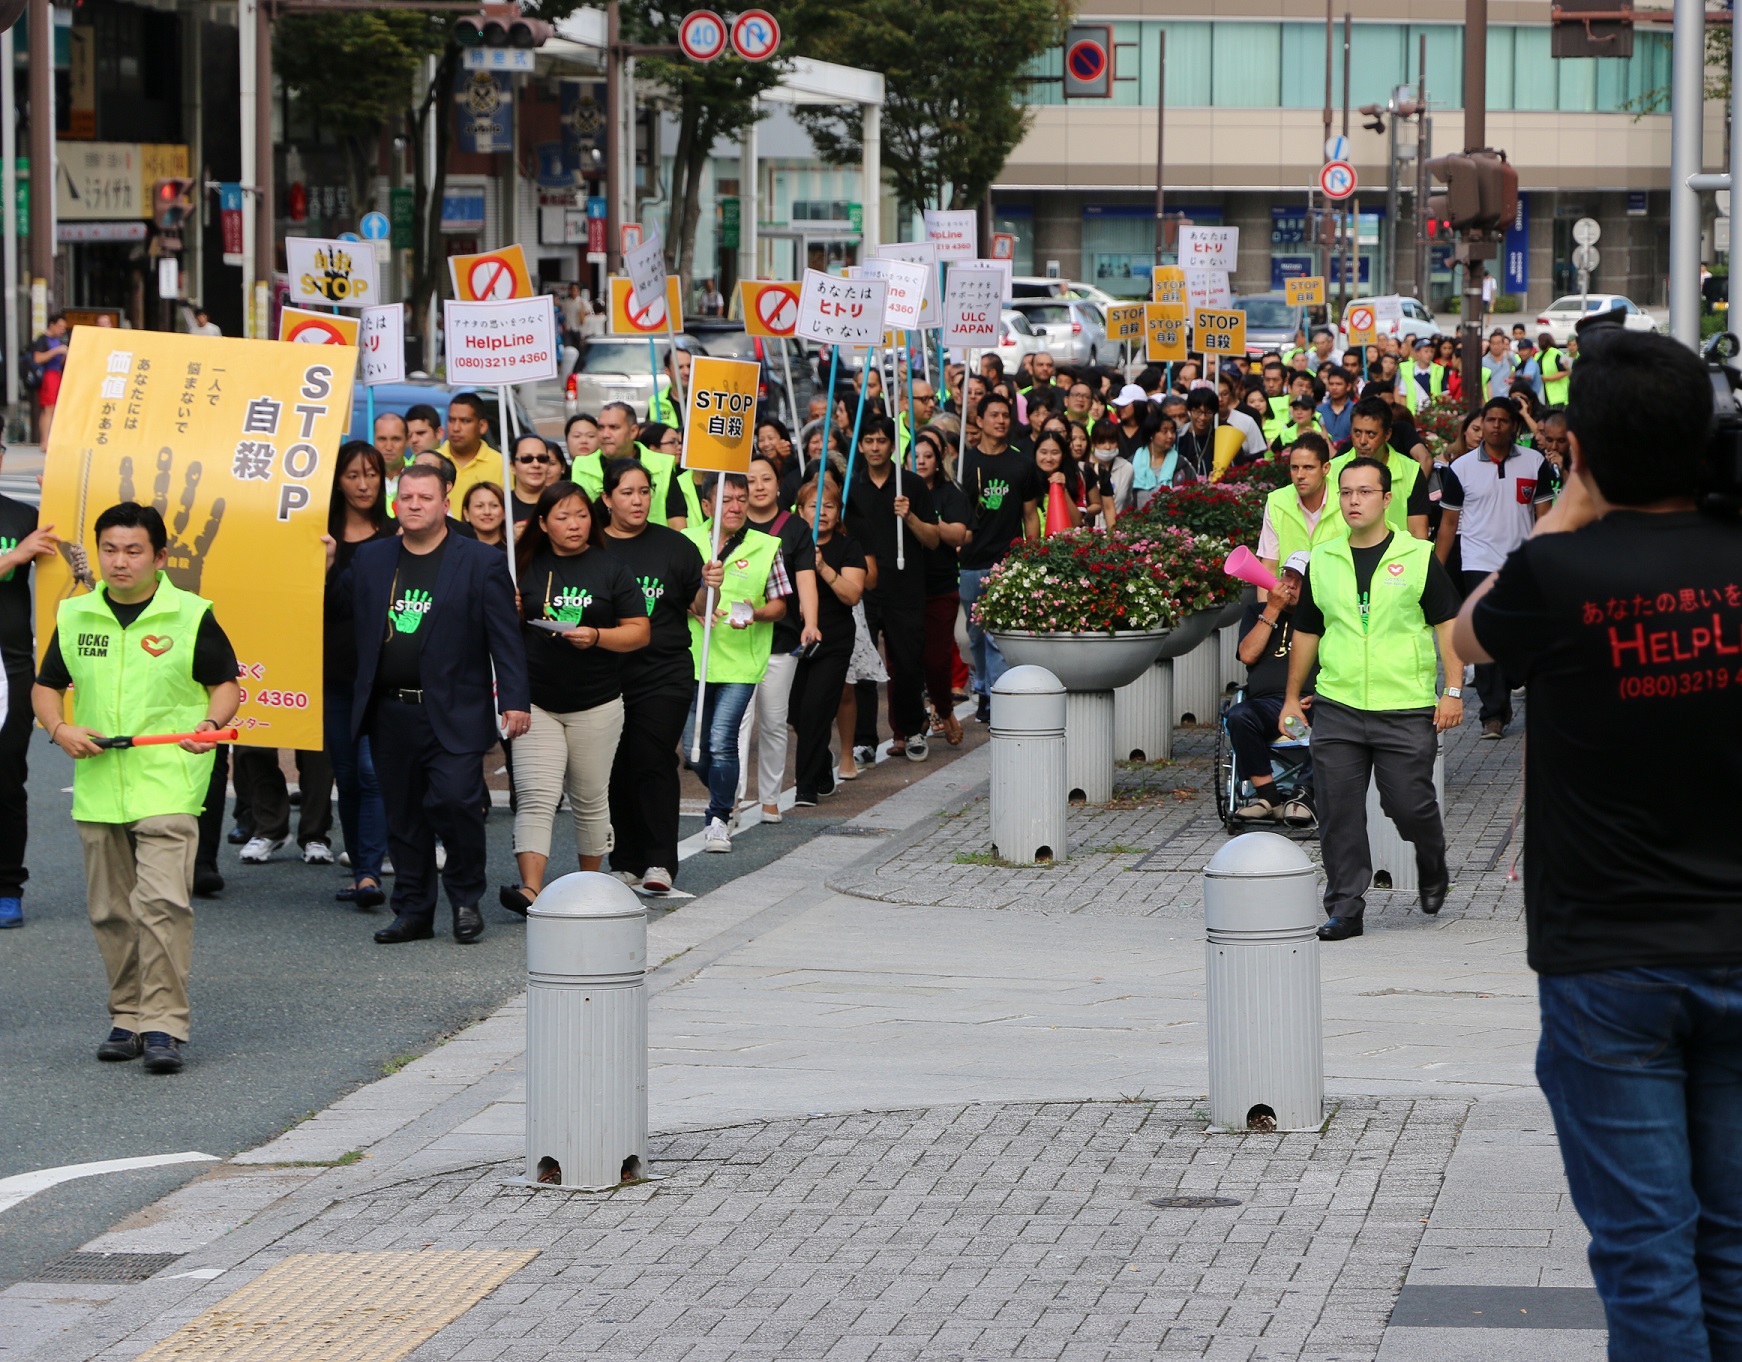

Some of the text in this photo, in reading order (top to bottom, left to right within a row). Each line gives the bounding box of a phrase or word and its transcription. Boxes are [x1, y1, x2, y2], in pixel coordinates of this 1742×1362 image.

[690, 25, 716, 46] 40
[1190, 232, 1228, 240] あなたは
[1194, 243, 1222, 252] ヒトリ
[1190, 257, 1227, 266] じゃない
[300, 274, 368, 298] STOP
[817, 281, 872, 299] あなたは
[1157, 281, 1185, 290] STOP
[1291, 281, 1319, 290] STOP
[819, 299, 863, 318] ヒトリ
[888, 304, 913, 314] 4360
[961, 312, 986, 321] ULC
[1112, 307, 1144, 320] STOP
[454, 314, 544, 329] アナタの思いをつなぐ
[812, 320, 868, 336] じゃない
[952, 324, 993, 333] JAPAN
[1150, 319, 1182, 330] STOP
[1199, 313, 1239, 330] STOP
[465, 333, 534, 351] HelpLine
[1206, 333, 1231, 349] 自殺
[455, 351, 548, 369] (080)3219 4360
[124, 358, 150, 430] あなたには
[206, 366, 226, 406] 一人で
[96, 349, 134, 446] 価値がある
[175, 362, 201, 434] 悩まないで
[695, 390, 754, 413] STOP
[707, 415, 743, 437] 自殺
[231, 396, 283, 482] 自殺
[276, 364, 333, 522] STOP
[984, 487, 1009, 497] STOP
[395, 599, 431, 613] STOP
[553, 596, 592, 608] STOP
[1582, 583, 1741, 625] あなたの思いを
[78, 633, 109, 647] UCKG
[1608, 613, 1742, 668] HELPL
[78, 647, 107, 657] TEAM
[1619, 667, 1729, 700] (080)3219
[257, 689, 308, 708] 4360
